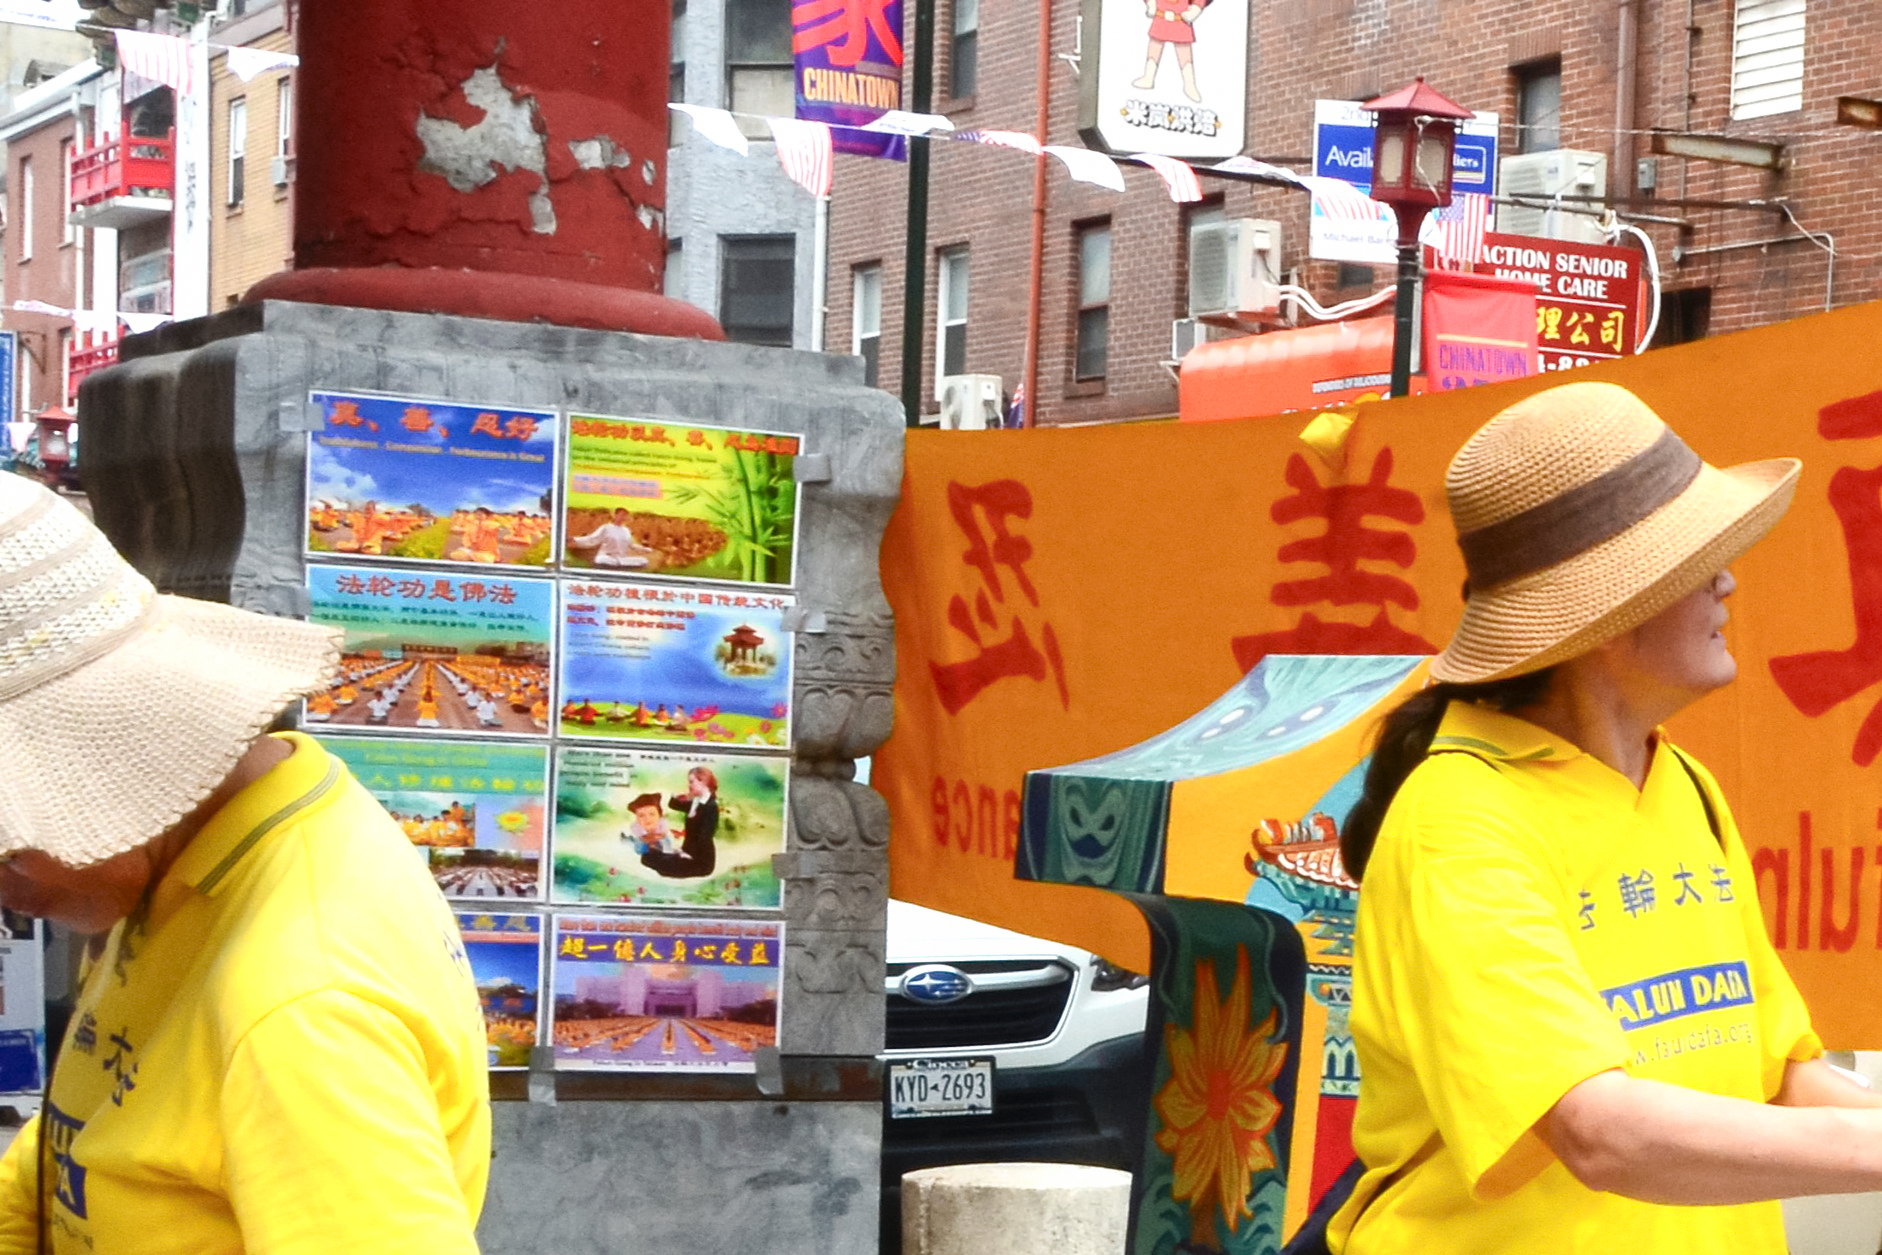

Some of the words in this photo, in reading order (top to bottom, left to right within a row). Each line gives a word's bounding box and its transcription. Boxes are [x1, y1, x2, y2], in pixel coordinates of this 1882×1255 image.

[803, 67, 899, 109] CHINATOWN
[1483, 245, 1550, 270] ACTION
[1555, 253, 1628, 279] SENIOR
[1557, 276, 1608, 299] CARE
[1536, 306, 1625, 353] 理公司
[1439, 345, 1528, 377] CHINATOWN
[1611, 978, 1686, 1023] ALUN
